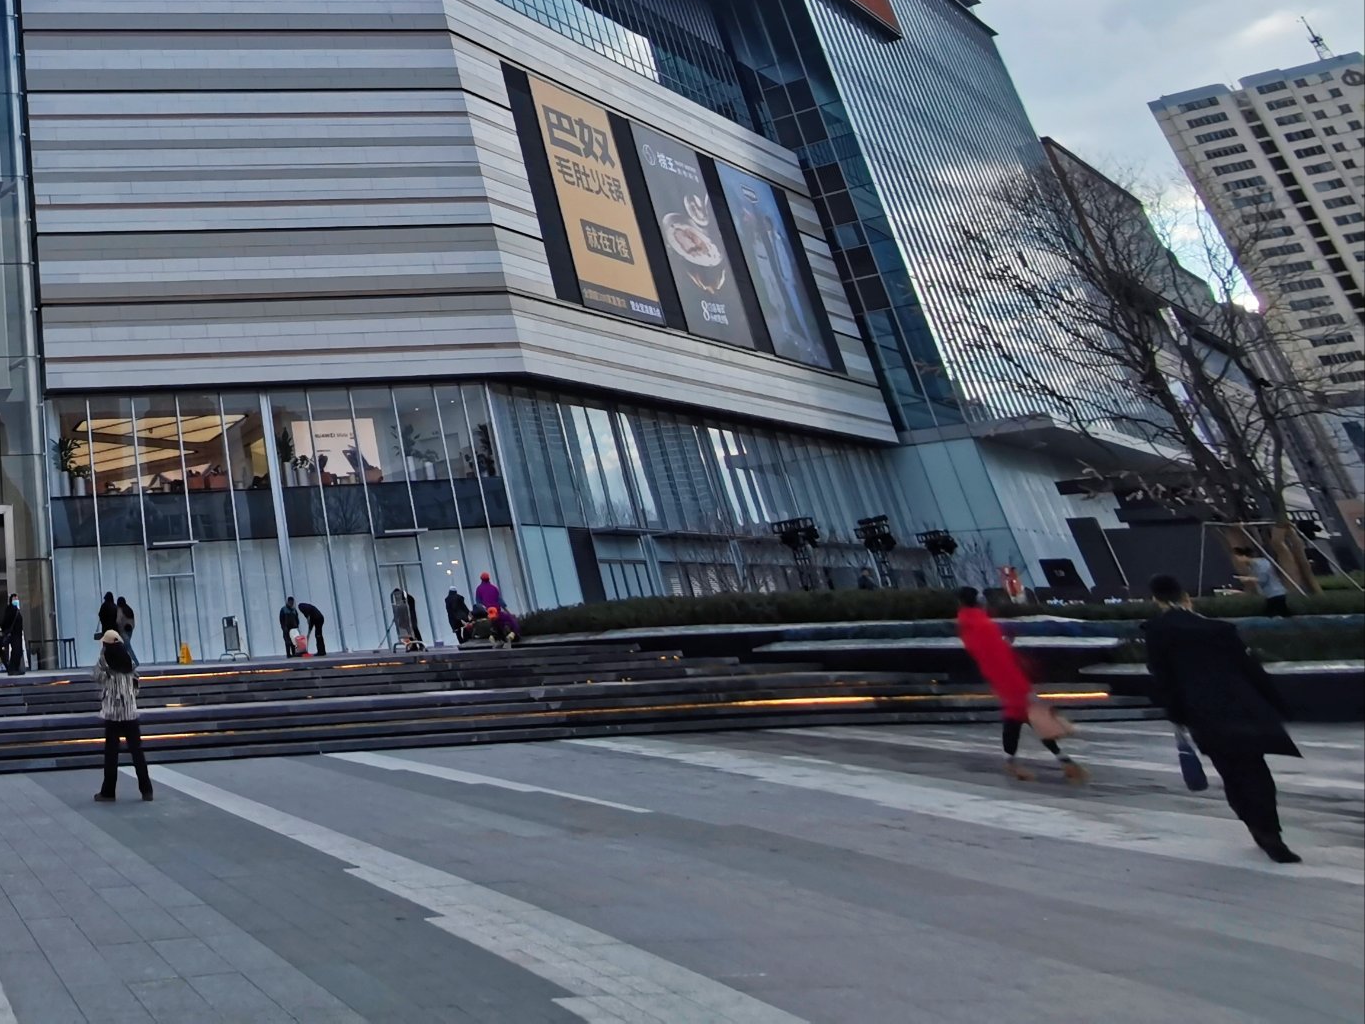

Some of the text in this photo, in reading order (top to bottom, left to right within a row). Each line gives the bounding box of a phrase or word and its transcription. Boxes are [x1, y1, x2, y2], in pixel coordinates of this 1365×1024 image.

[542, 104, 615, 168] 巴奴
[554, 155, 626, 205] 毛肚火锅
[585, 228, 630, 258] 就在7楼
